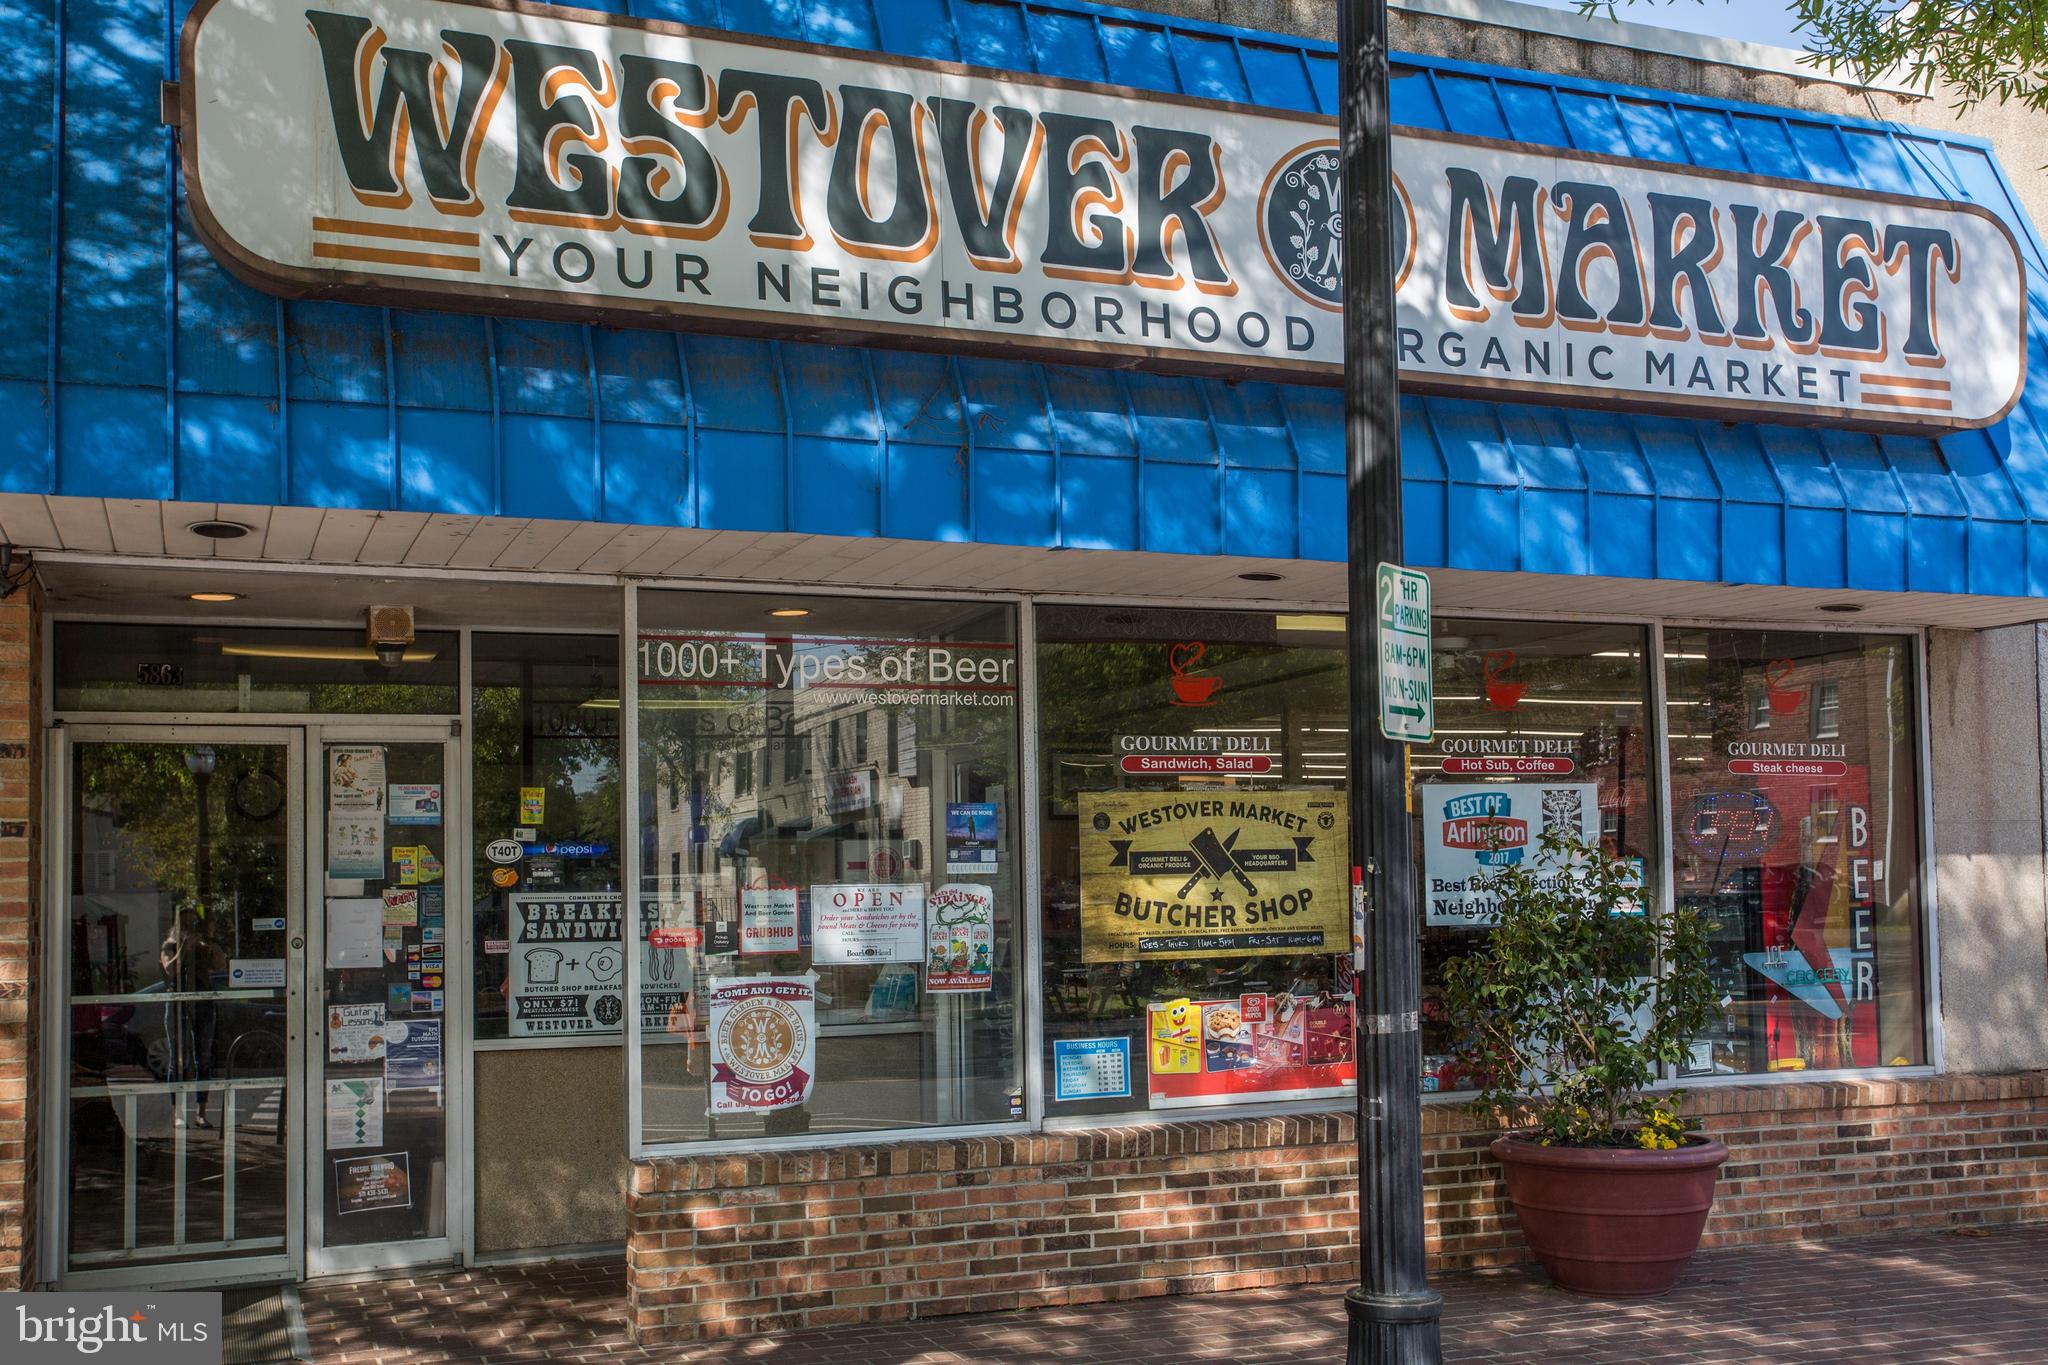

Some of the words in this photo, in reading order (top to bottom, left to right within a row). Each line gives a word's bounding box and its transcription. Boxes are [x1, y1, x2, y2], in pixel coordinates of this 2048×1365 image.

[306, 9, 1240, 297] WESTOVER
[1446, 166, 1961, 369] MARKET
[493, 233, 712, 297] YOUR
[758, 259, 1315, 353] NEIGHBORHOOD
[1397, 327, 1615, 382] RGANIC
[1645, 350, 1852, 404] MARKET
[1402, 580, 1418, 602] HR
[1381, 575, 1393, 622] 2
[1394, 604, 1427, 630] PARKING
[1384, 642, 1426, 669] 8AM-6PM
[638, 642, 740, 678] 1000+
[751, 645, 867, 689] Types
[880, 647, 916, 682] of
[928, 649, 1014, 684] Beer
[1384, 675, 1428, 703] MON-SUN
[813, 691, 1014, 707] www.westovermarket.com
[1120, 735, 1222, 751] GOURMET
[1227, 736, 1271, 751] DELI
[1441, 738, 1529, 754] GOURMET
[1534, 739, 1573, 754] DELI
[1727, 742, 1808, 757] GOURMET
[1811, 743, 1846, 757] DELI
[1141, 757, 1212, 771] Sandwich,
[1216, 758, 1253, 770] Salad
[1461, 759, 1482, 771] Hot
[1485, 759, 1513, 772] Sub,
[1516, 759, 1555, 771] Coffee
[1752, 762, 1782, 774] Steak
[1785, 763, 1823, 775] cheese
[1450, 796, 1483, 817] BEST
[1485, 796, 1503, 814] OF
[1118, 800, 1225, 835] WESTOVER
[1229, 801, 1308, 833] MARKET
[491, 846, 518, 857] T40T
[560, 845, 592, 857] pepsi
[1489, 852, 1509, 864] 2017
[1432, 879, 1466, 892] Best
[773, 901, 795, 909] Market
[833, 892, 903, 907] OPEN
[1114, 891, 1236, 928] BUTCHER
[1246, 887, 1314, 924] SHOP
[855, 913, 890, 921] Sandwiches
[898, 913, 907, 921] by
[746, 926, 794, 939] GRUBHUB
[817, 923, 838, 931] pound
[865, 921, 888, 929] Cheeses
[888, 921, 898, 930] for
[898, 920, 919, 930] pickup
[1109, 941, 1137, 949] HOURS:
[584, 983, 623, 991] BREAKFAS
[716, 988, 749, 999] COME
[750, 986, 773, 994] AND
[775, 986, 796, 995] GET
[523, 1001, 554, 1009] ONLY
[560, 998, 579, 1008] $7!
[343, 1007, 373, 1017] Guitar
[341, 1017, 373, 1027] Lessons
[526, 1019, 594, 1031] WESTOVER
[721, 1020, 733, 1045] BEER
[730, 999, 765, 1021] GARDEN
[774, 1000, 795, 1019] BEER
[1066, 1042, 1097, 1050] BUSINESS
[1097, 1040, 1118, 1048] HOURS
[729, 1058, 772, 1080] WESTOVER
[741, 1086, 762, 1102] TO
[763, 1081, 793, 1101] GO!
[717, 1101, 733, 1109] Call
